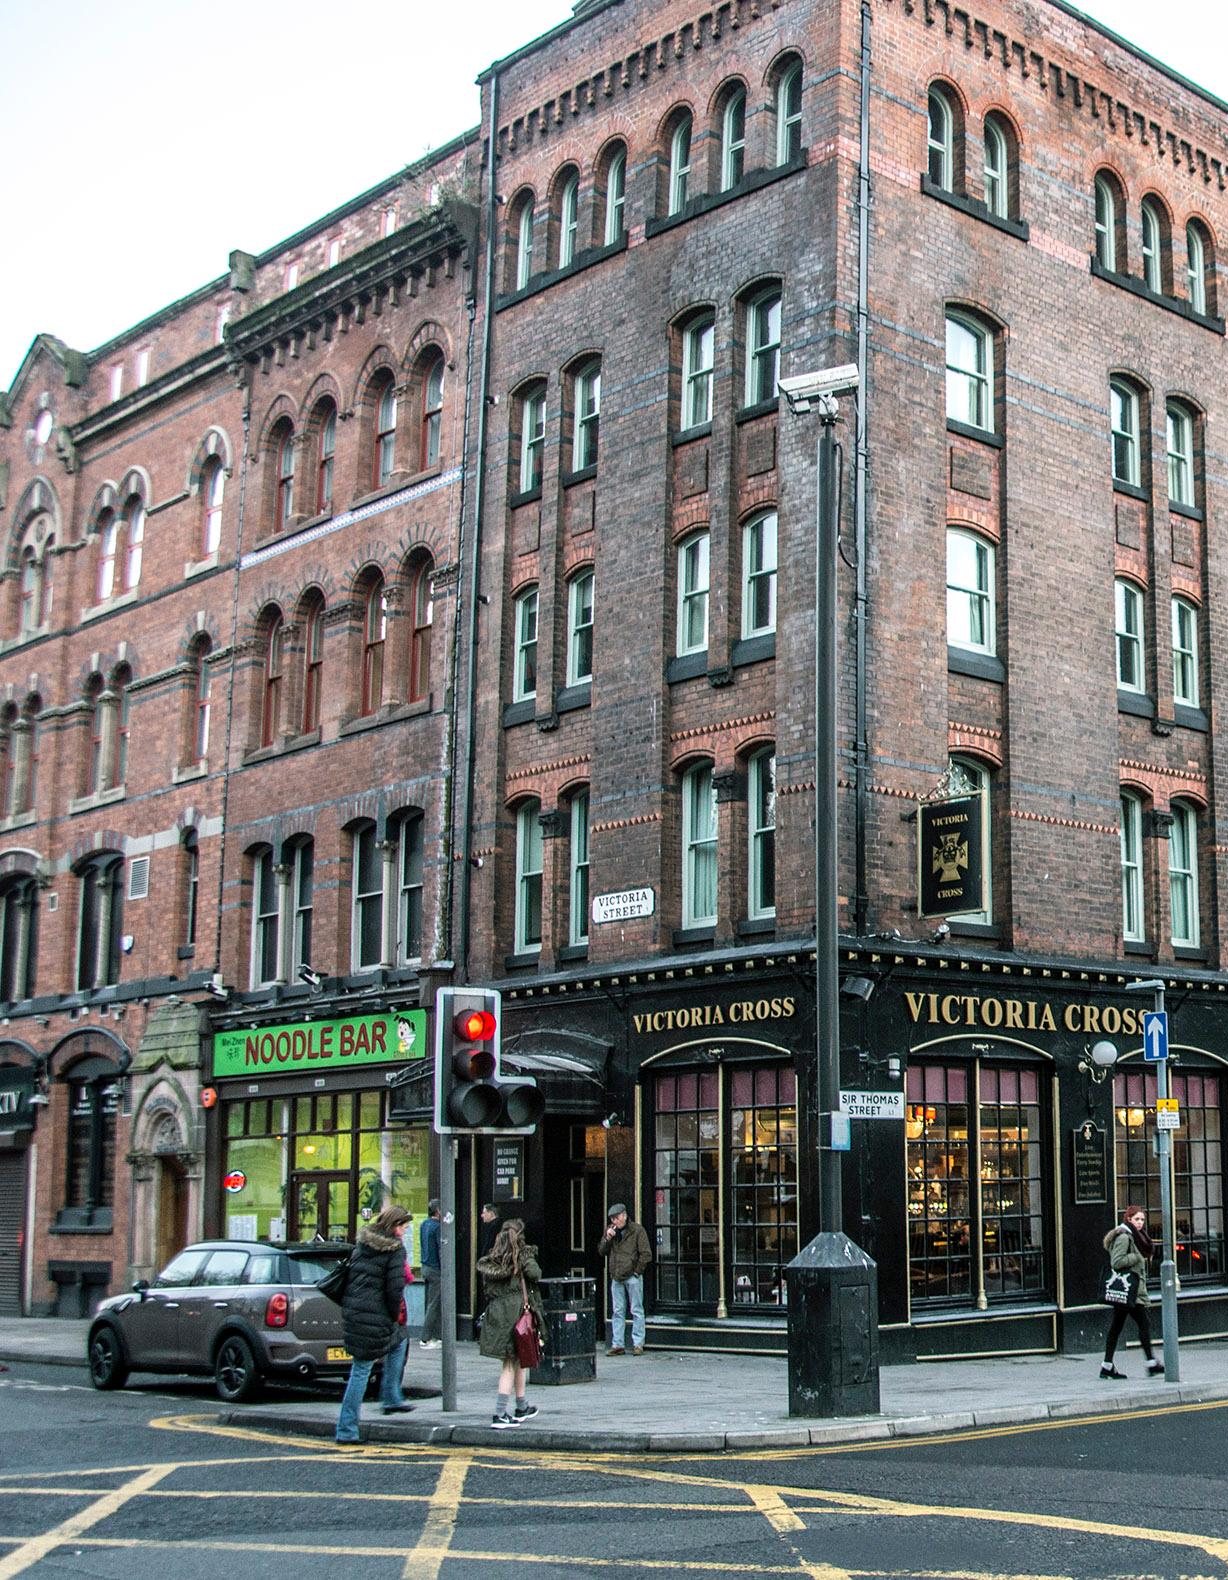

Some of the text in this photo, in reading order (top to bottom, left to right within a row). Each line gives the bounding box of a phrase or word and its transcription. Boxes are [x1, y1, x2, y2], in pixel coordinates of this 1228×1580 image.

[932, 813, 968, 827] VICTORIA
[598, 891, 648, 907] VICTORIA
[937, 887, 963, 899] CROSS
[603, 904, 643, 919] STREET
[633, 996, 795, 1034] VICTORIA CROSS
[904, 992, 1152, 1035] VICTORIA CROSS
[246, 1020, 388, 1066] NOODLE BAR
[842, 1094, 899, 1105] SIR THOMAS
[849, 1105, 882, 1116] STREET
